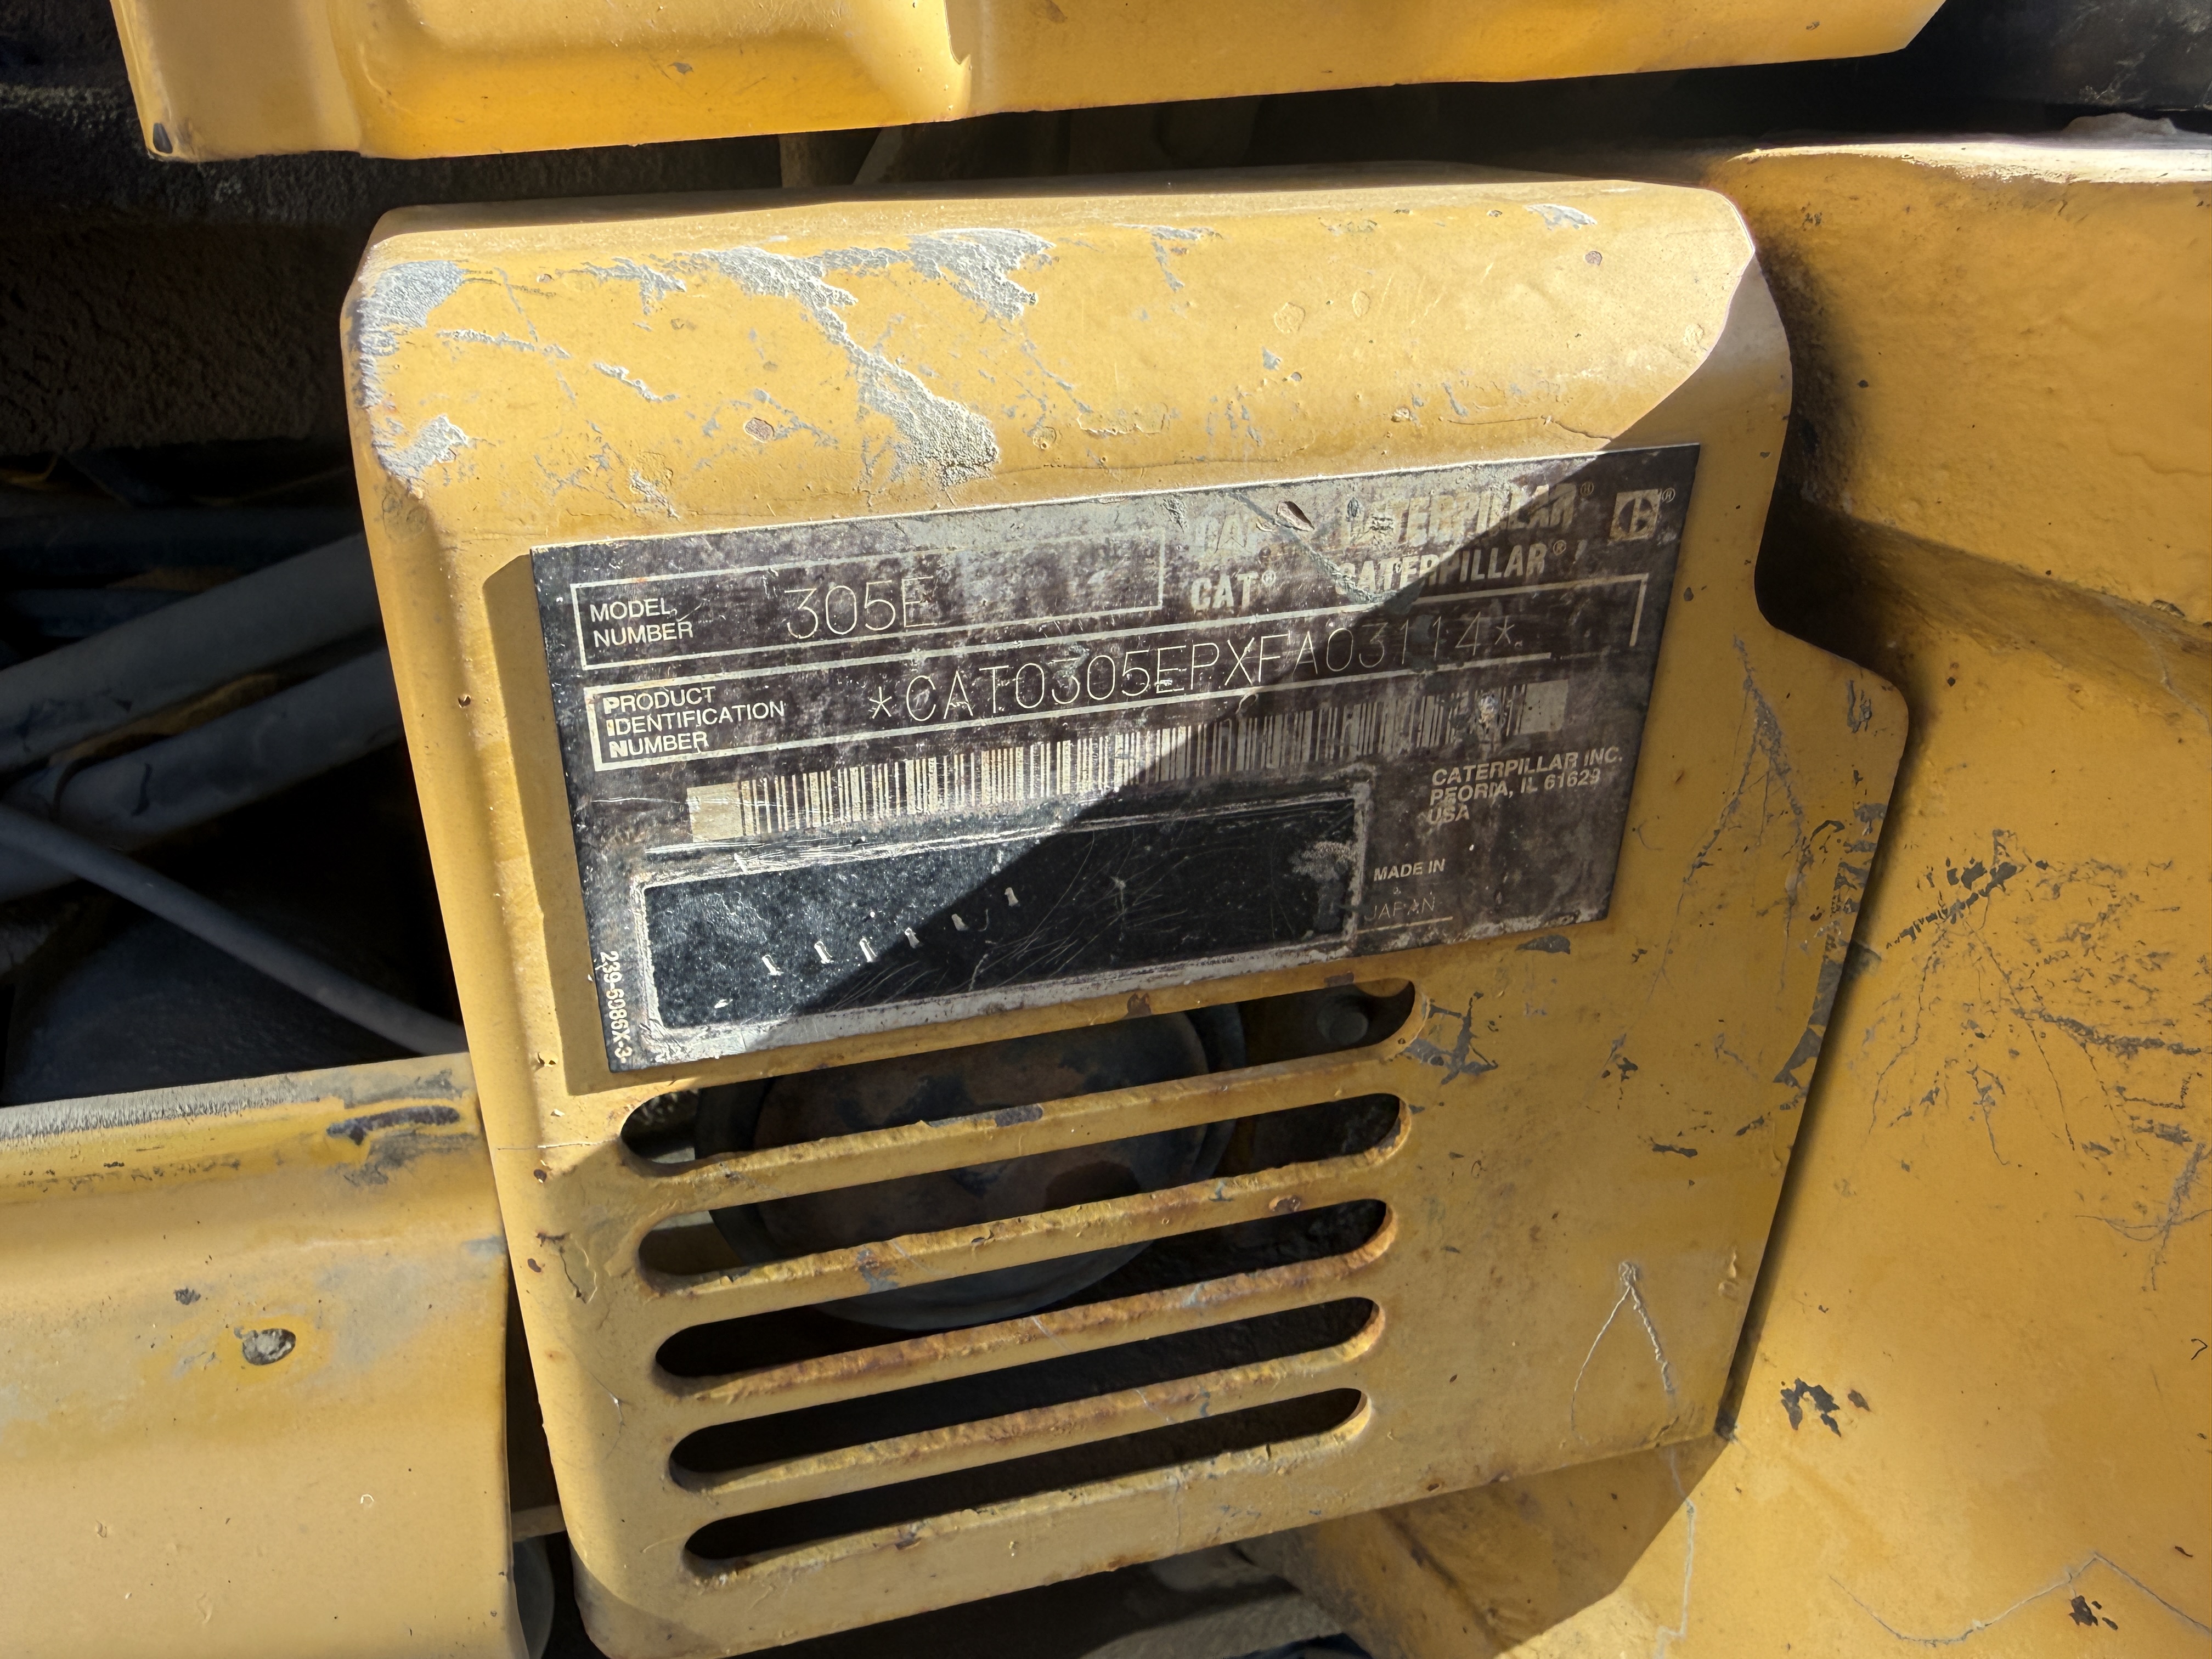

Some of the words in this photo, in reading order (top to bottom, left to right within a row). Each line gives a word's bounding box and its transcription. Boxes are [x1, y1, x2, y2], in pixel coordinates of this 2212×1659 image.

[590, 597, 672, 622] MODEL
[594, 620, 693, 648] NUMBER
[603, 686, 716, 714] PRODUCT
[607, 701, 785, 737] IDENTIFICATION
[610, 731, 709, 758] NUMBER
[1432, 752, 1578, 786] CATERPILLAR
[1583, 745, 1623, 767] INC.
[1429, 780, 1513, 806] PEORIA,
[1520, 776, 1538, 794] IL
[1426, 804, 1470, 824] USA
[1373, 861, 1424, 882] MADE
[1428, 858, 1446, 874] IN
